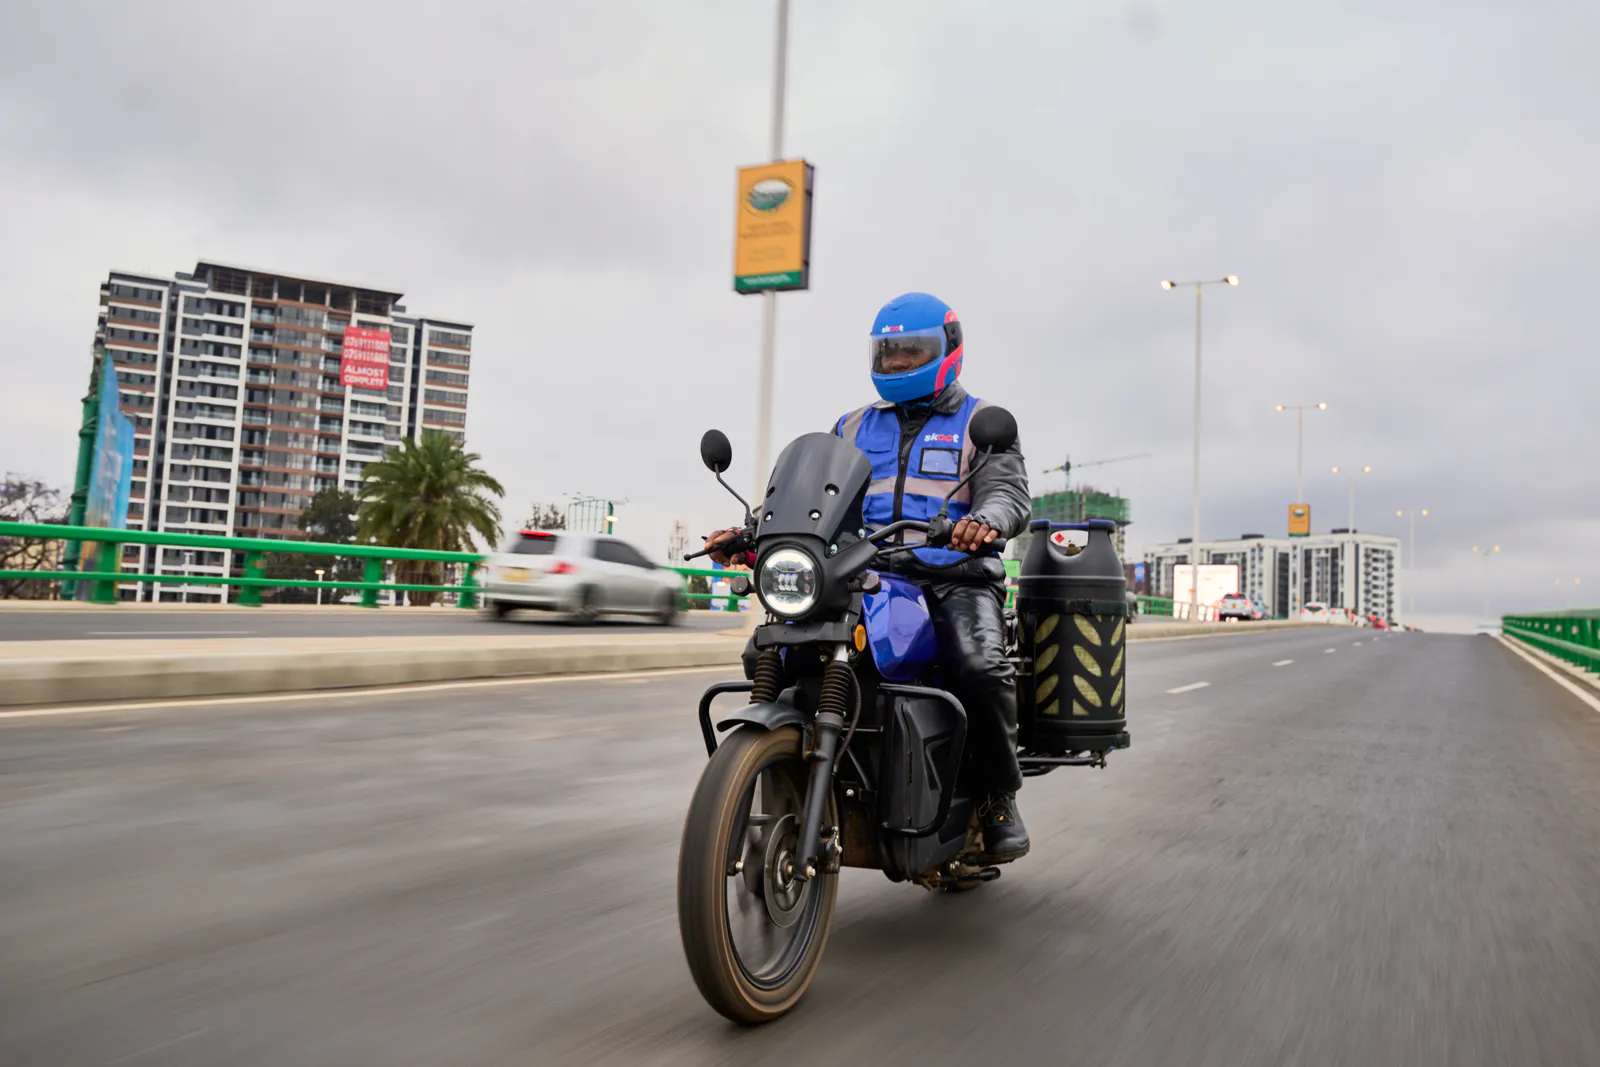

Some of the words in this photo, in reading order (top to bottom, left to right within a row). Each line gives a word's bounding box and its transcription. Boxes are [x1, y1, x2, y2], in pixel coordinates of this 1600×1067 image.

[344, 365, 385, 378] ALMOST
[344, 374, 385, 387] COMPLETE
[923, 432, 960, 443] skoot
